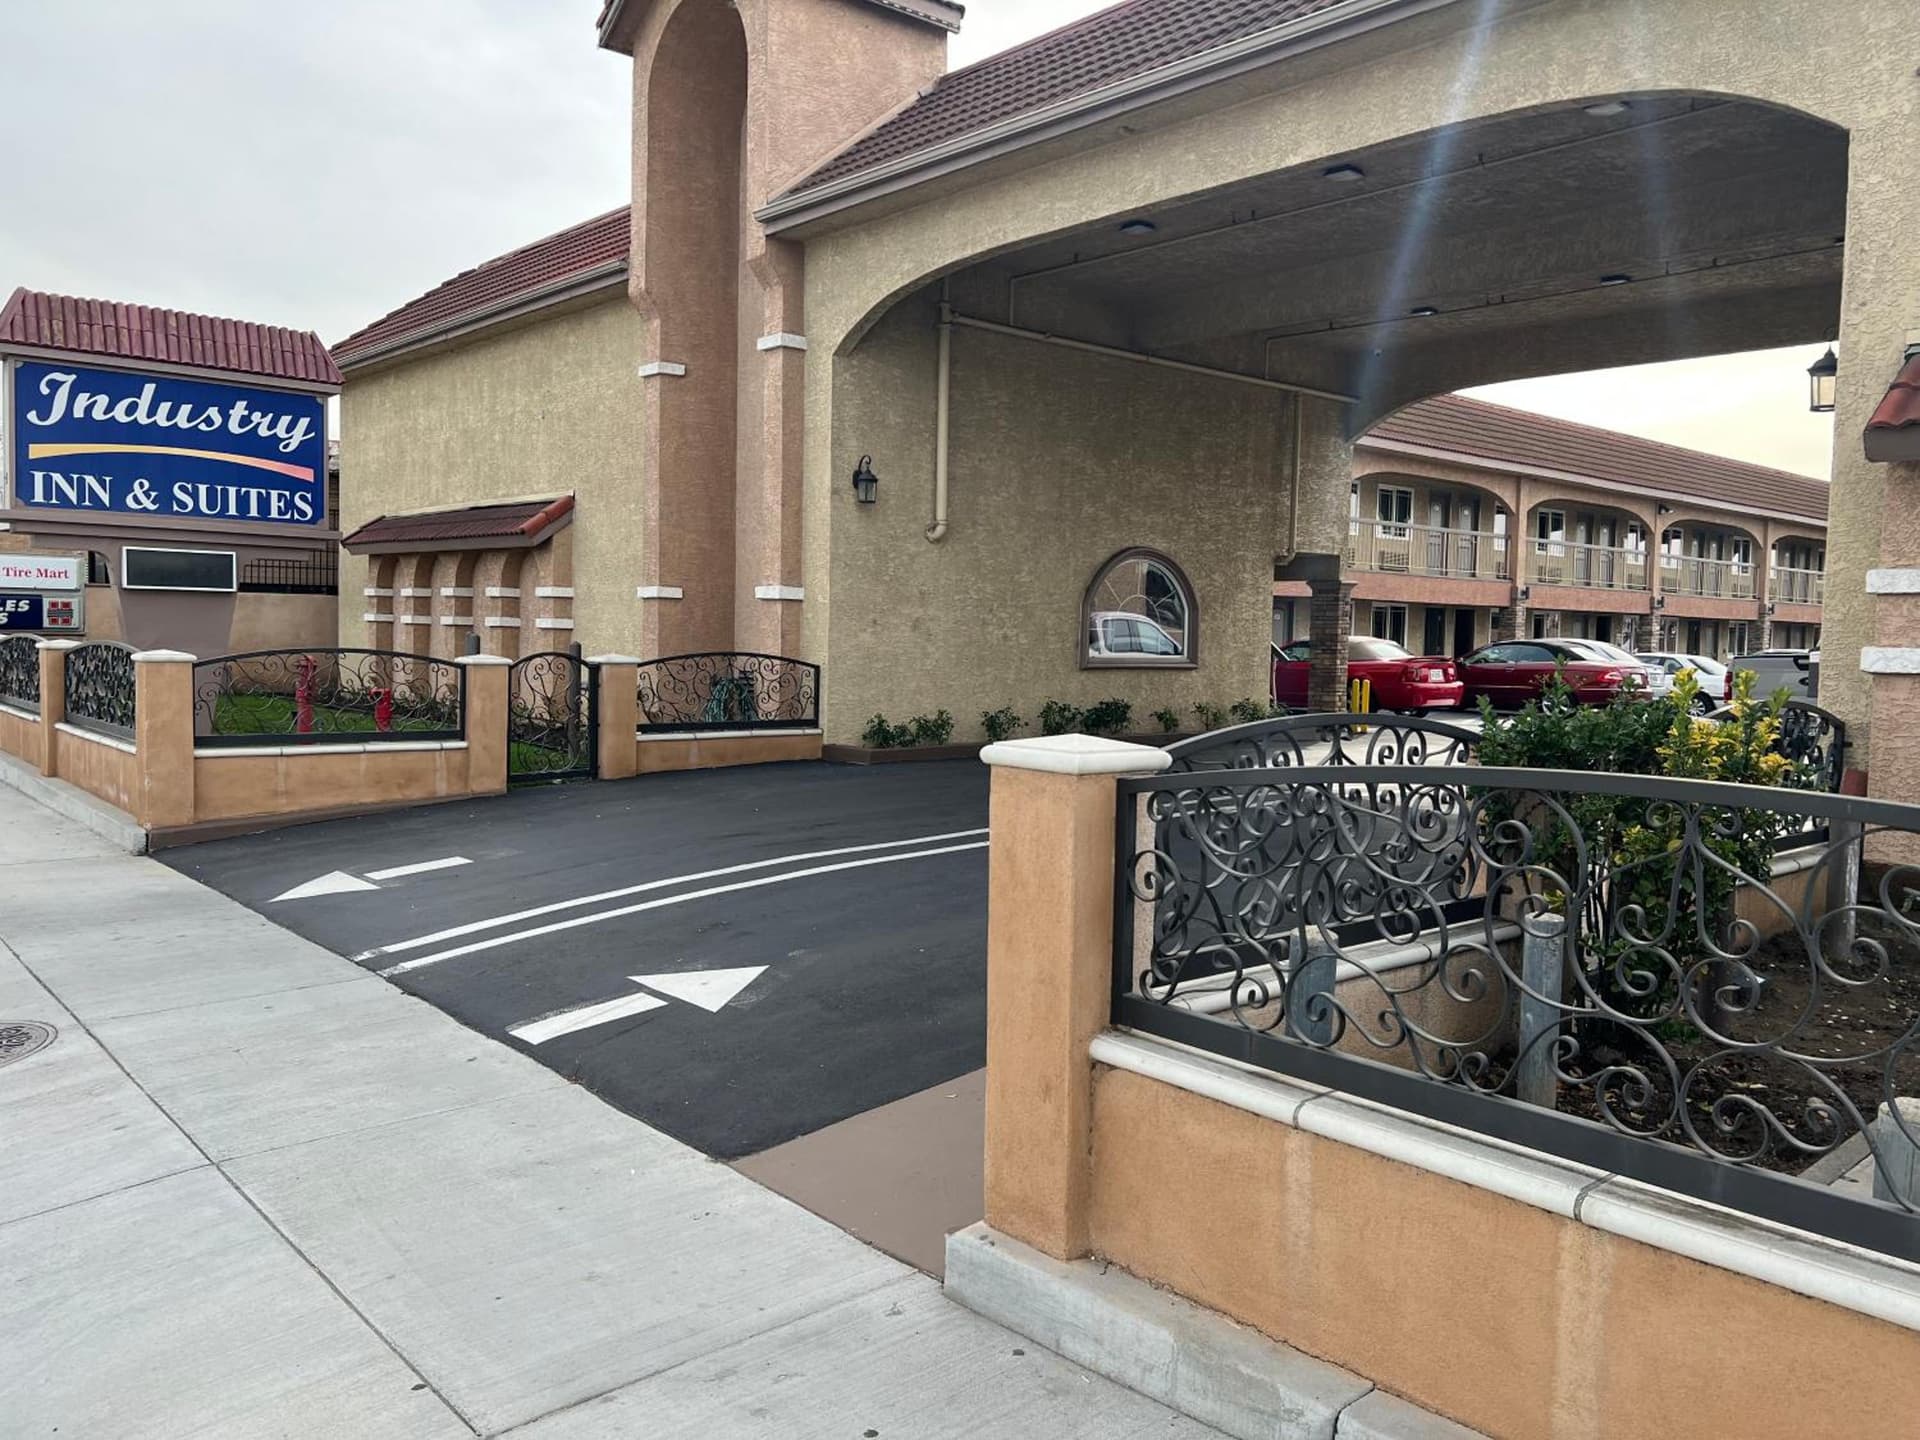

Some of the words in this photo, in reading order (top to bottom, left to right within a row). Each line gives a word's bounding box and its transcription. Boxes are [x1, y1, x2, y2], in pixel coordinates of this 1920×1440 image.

[26, 372, 315, 452] Industry
[30, 470, 113, 507] INN
[126, 478, 159, 510] &
[172, 481, 313, 520] SUITES
[2, 567, 32, 578] Tire
[36, 568, 69, 579] Mart
[0, 600, 30, 612] ES
